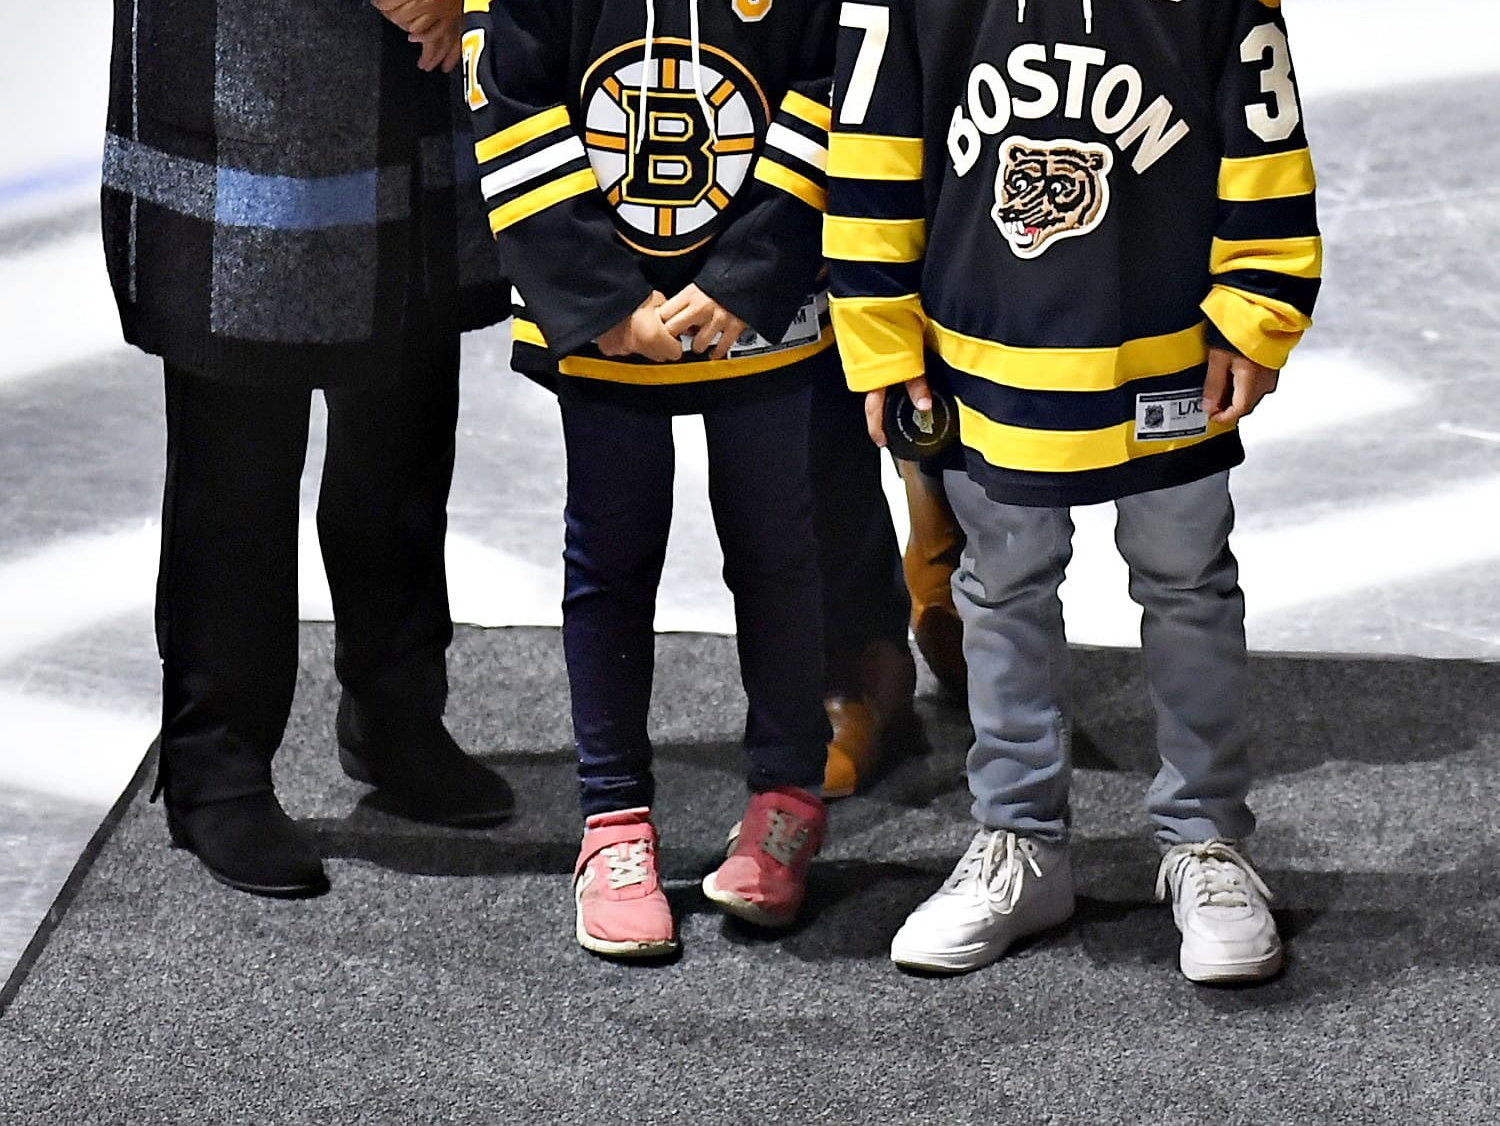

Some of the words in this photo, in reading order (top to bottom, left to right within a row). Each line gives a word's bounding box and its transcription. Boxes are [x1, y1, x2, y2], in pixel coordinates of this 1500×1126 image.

[839, 1, 890, 125] 7
[947, 43, 1189, 177] BOSTON
[1239, 22, 1299, 143] 3
[621, 89, 715, 207] B
[1178, 399, 1204, 416] L/X
